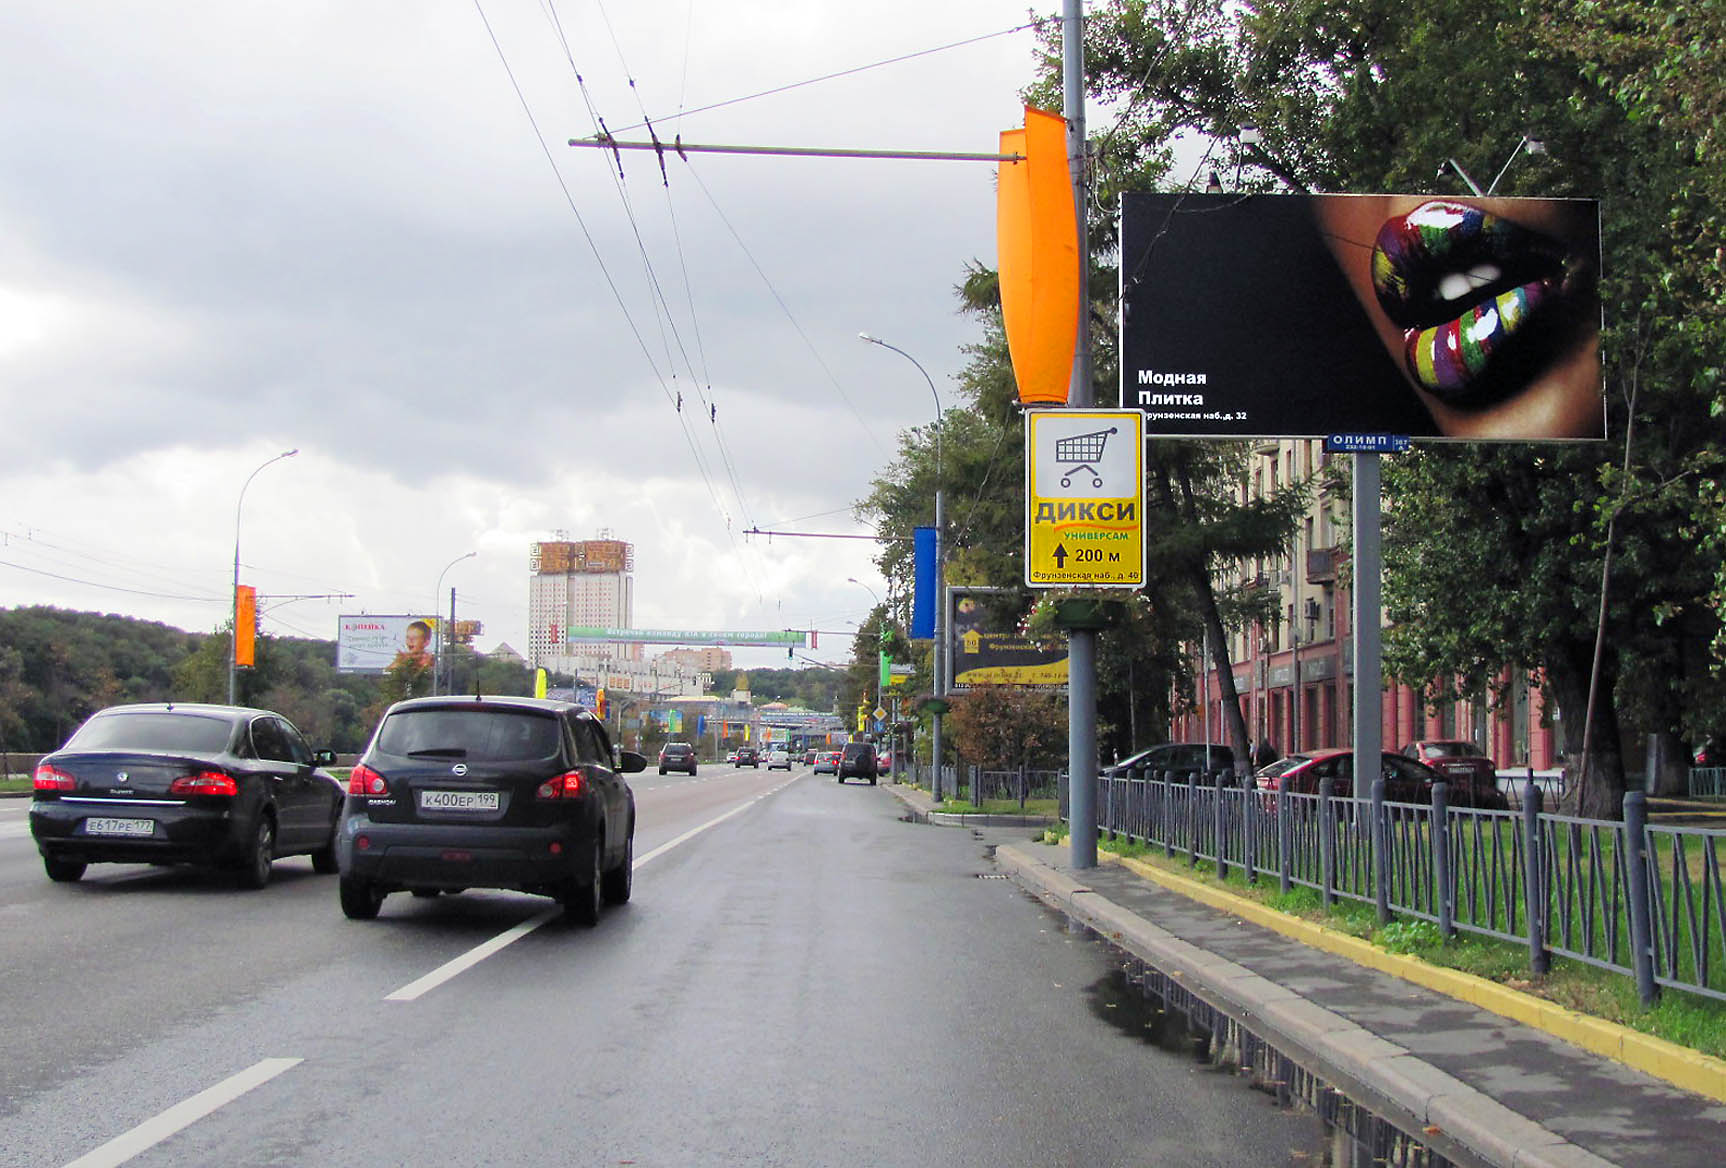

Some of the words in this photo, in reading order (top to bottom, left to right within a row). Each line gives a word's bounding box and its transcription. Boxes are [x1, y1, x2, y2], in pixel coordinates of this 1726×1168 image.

[1138, 369, 1207, 387] Модная
[1138, 390, 1204, 406] Плитка
[1146, 412, 1201, 421] рунзенская
[1236, 411, 1248, 420] 32
[1333, 435, 1387, 445] ОЛИМП
[1035, 502, 1135, 524] ДИКСИ
[1064, 531, 1129, 541] УНИВЕРСАМ
[1075, 548, 1103, 562] 200
[1108, 552, 1120, 562] м
[1033, 571, 1092, 581] Фрунзенская
[1128, 571, 1139, 580] 40
[477, 794, 496, 805] 199
